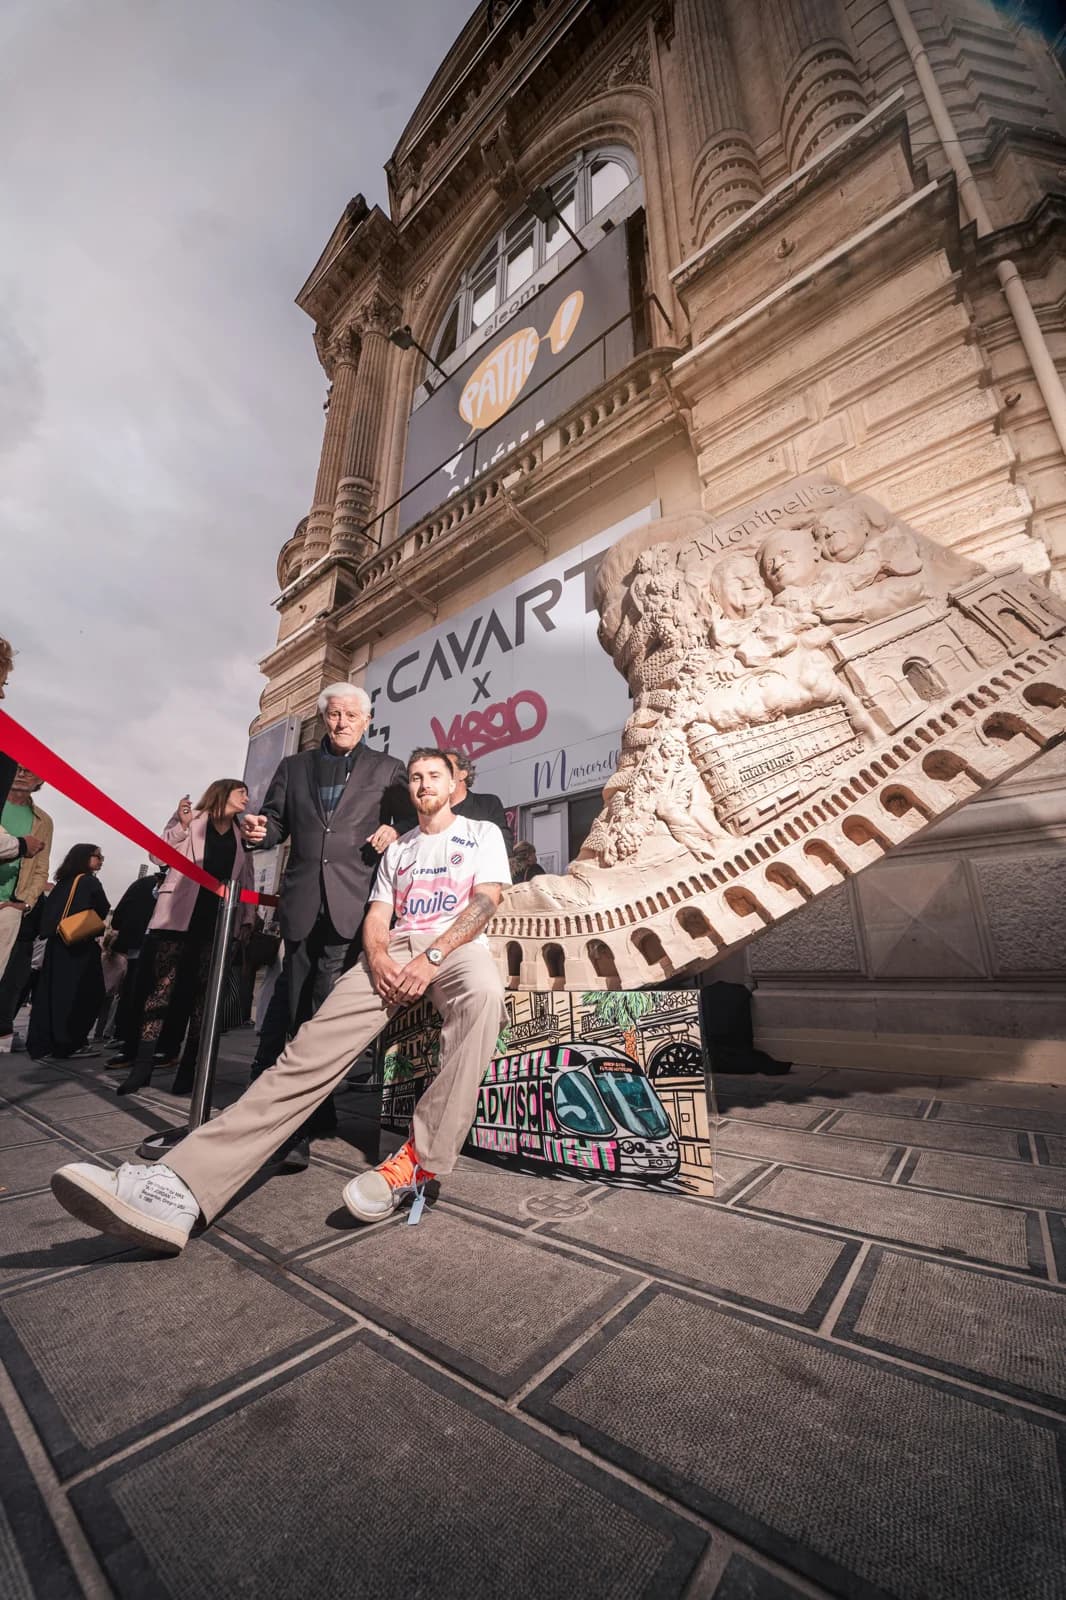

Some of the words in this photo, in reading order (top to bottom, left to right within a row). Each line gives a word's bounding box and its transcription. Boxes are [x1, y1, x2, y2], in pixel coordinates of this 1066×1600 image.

[386, 548, 609, 703] CAVART
[450, 835, 465, 846] BIG
[465, 840, 475, 849] M
[401, 890, 458, 916] swile
